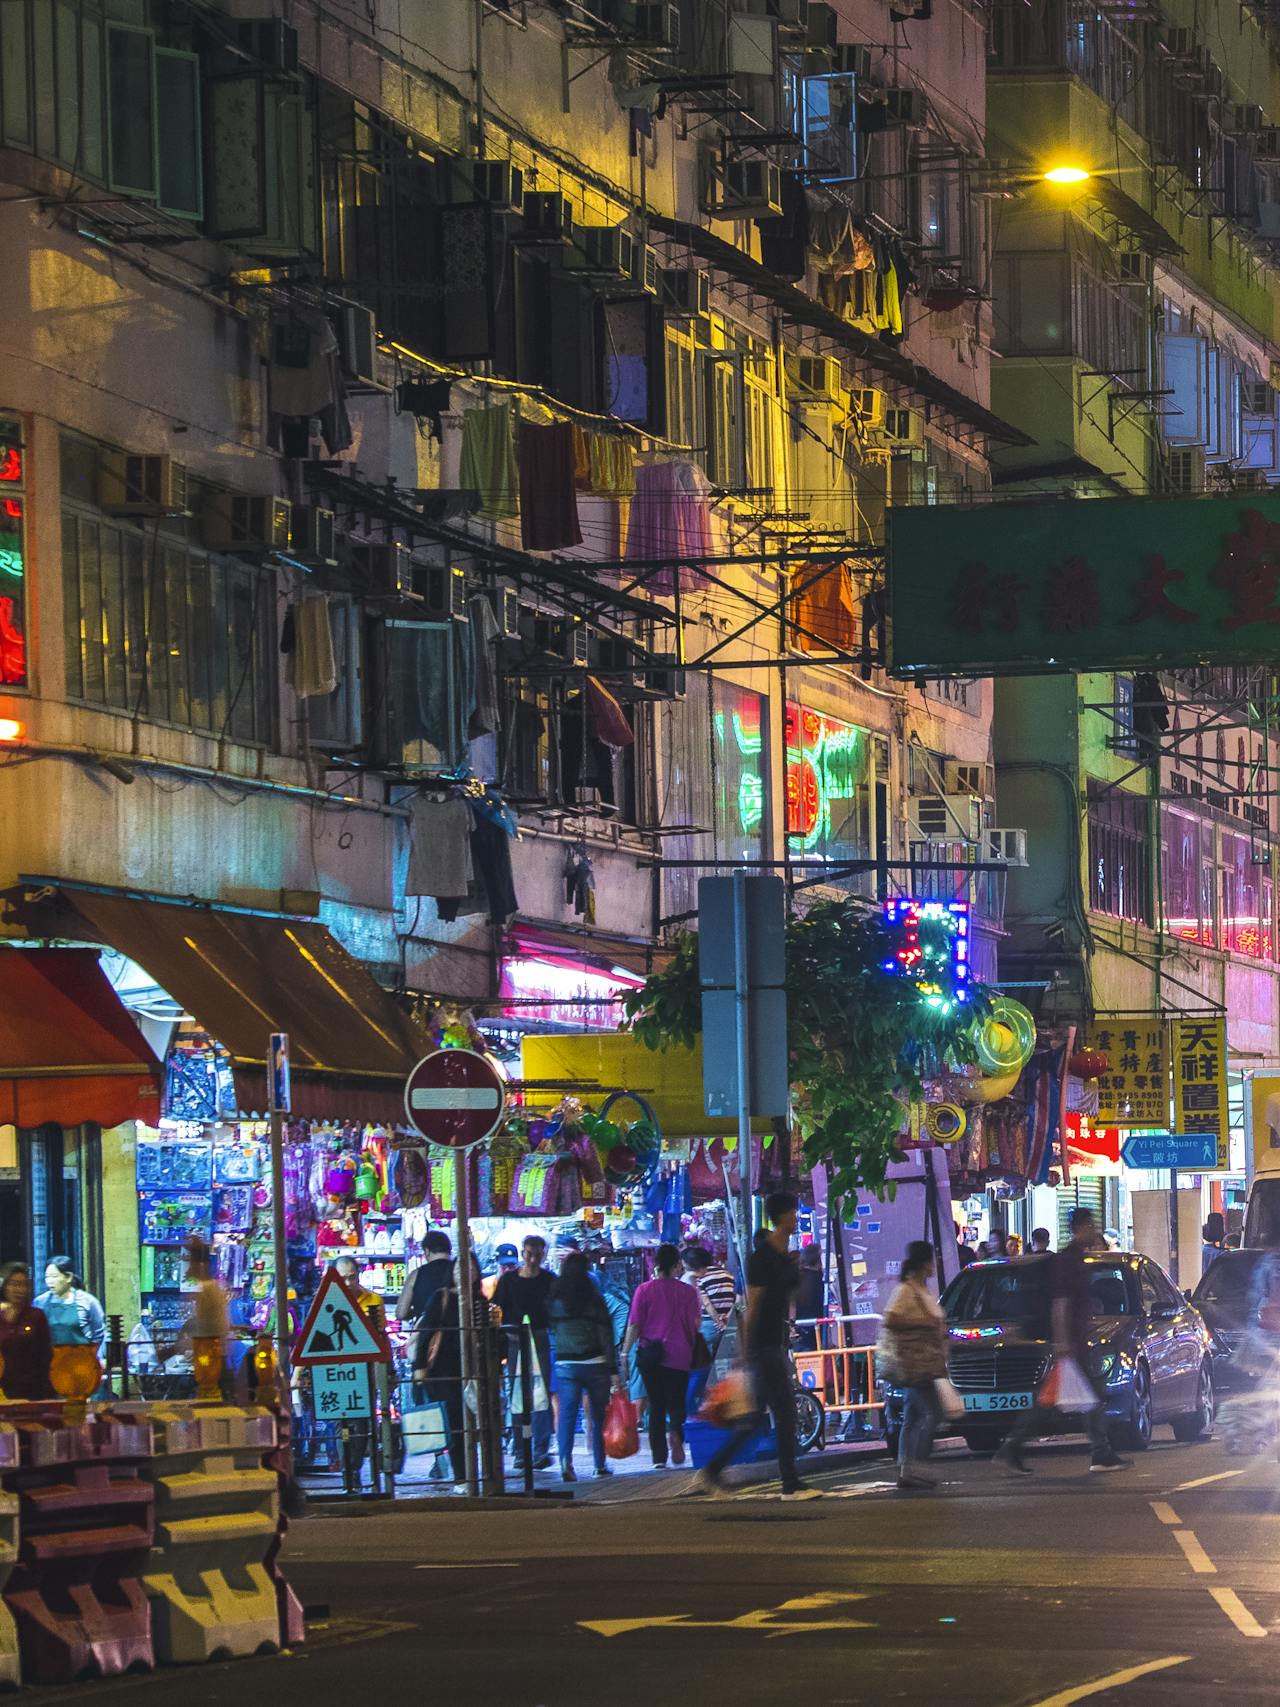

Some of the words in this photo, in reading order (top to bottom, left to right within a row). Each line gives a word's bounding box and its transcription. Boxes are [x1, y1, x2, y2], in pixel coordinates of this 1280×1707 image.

[1139, 1140, 1147, 1149] Yi
[1149, 1139, 1164, 1148] Pei
[1166, 1139, 1199, 1149] Square
[326, 1366, 356, 1382] End
[320, 1389, 365, 1413] 終止
[989, 1394, 1029, 1409] 5268
